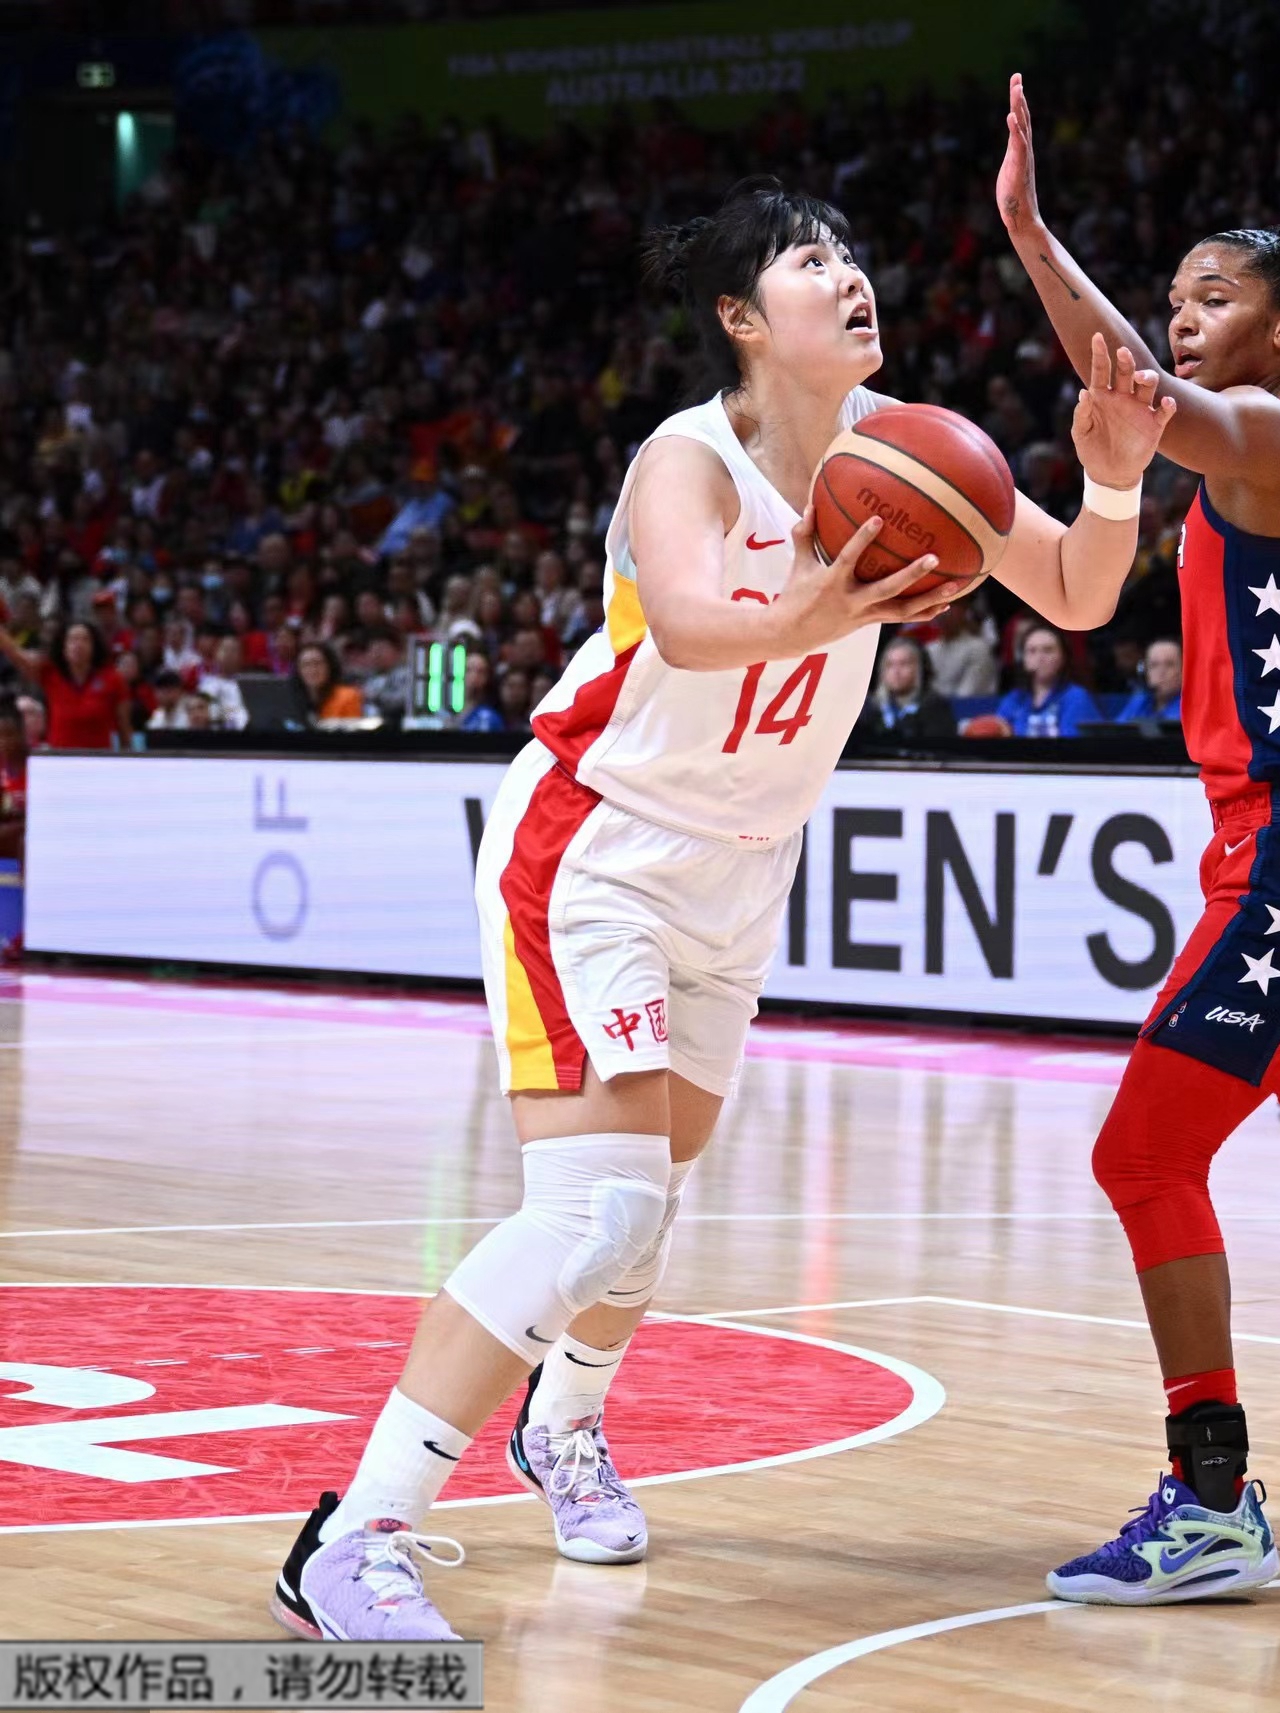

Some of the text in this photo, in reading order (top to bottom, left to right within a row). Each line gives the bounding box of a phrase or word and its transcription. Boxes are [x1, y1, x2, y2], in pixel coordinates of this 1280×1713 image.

[545, 60, 806, 106] AUSTRALIA 2022
[856, 487, 936, 549] molten
[721, 652, 829, 754] 14
[253, 774, 309, 943] OF
[1205, 1005, 1265, 1032] USA
